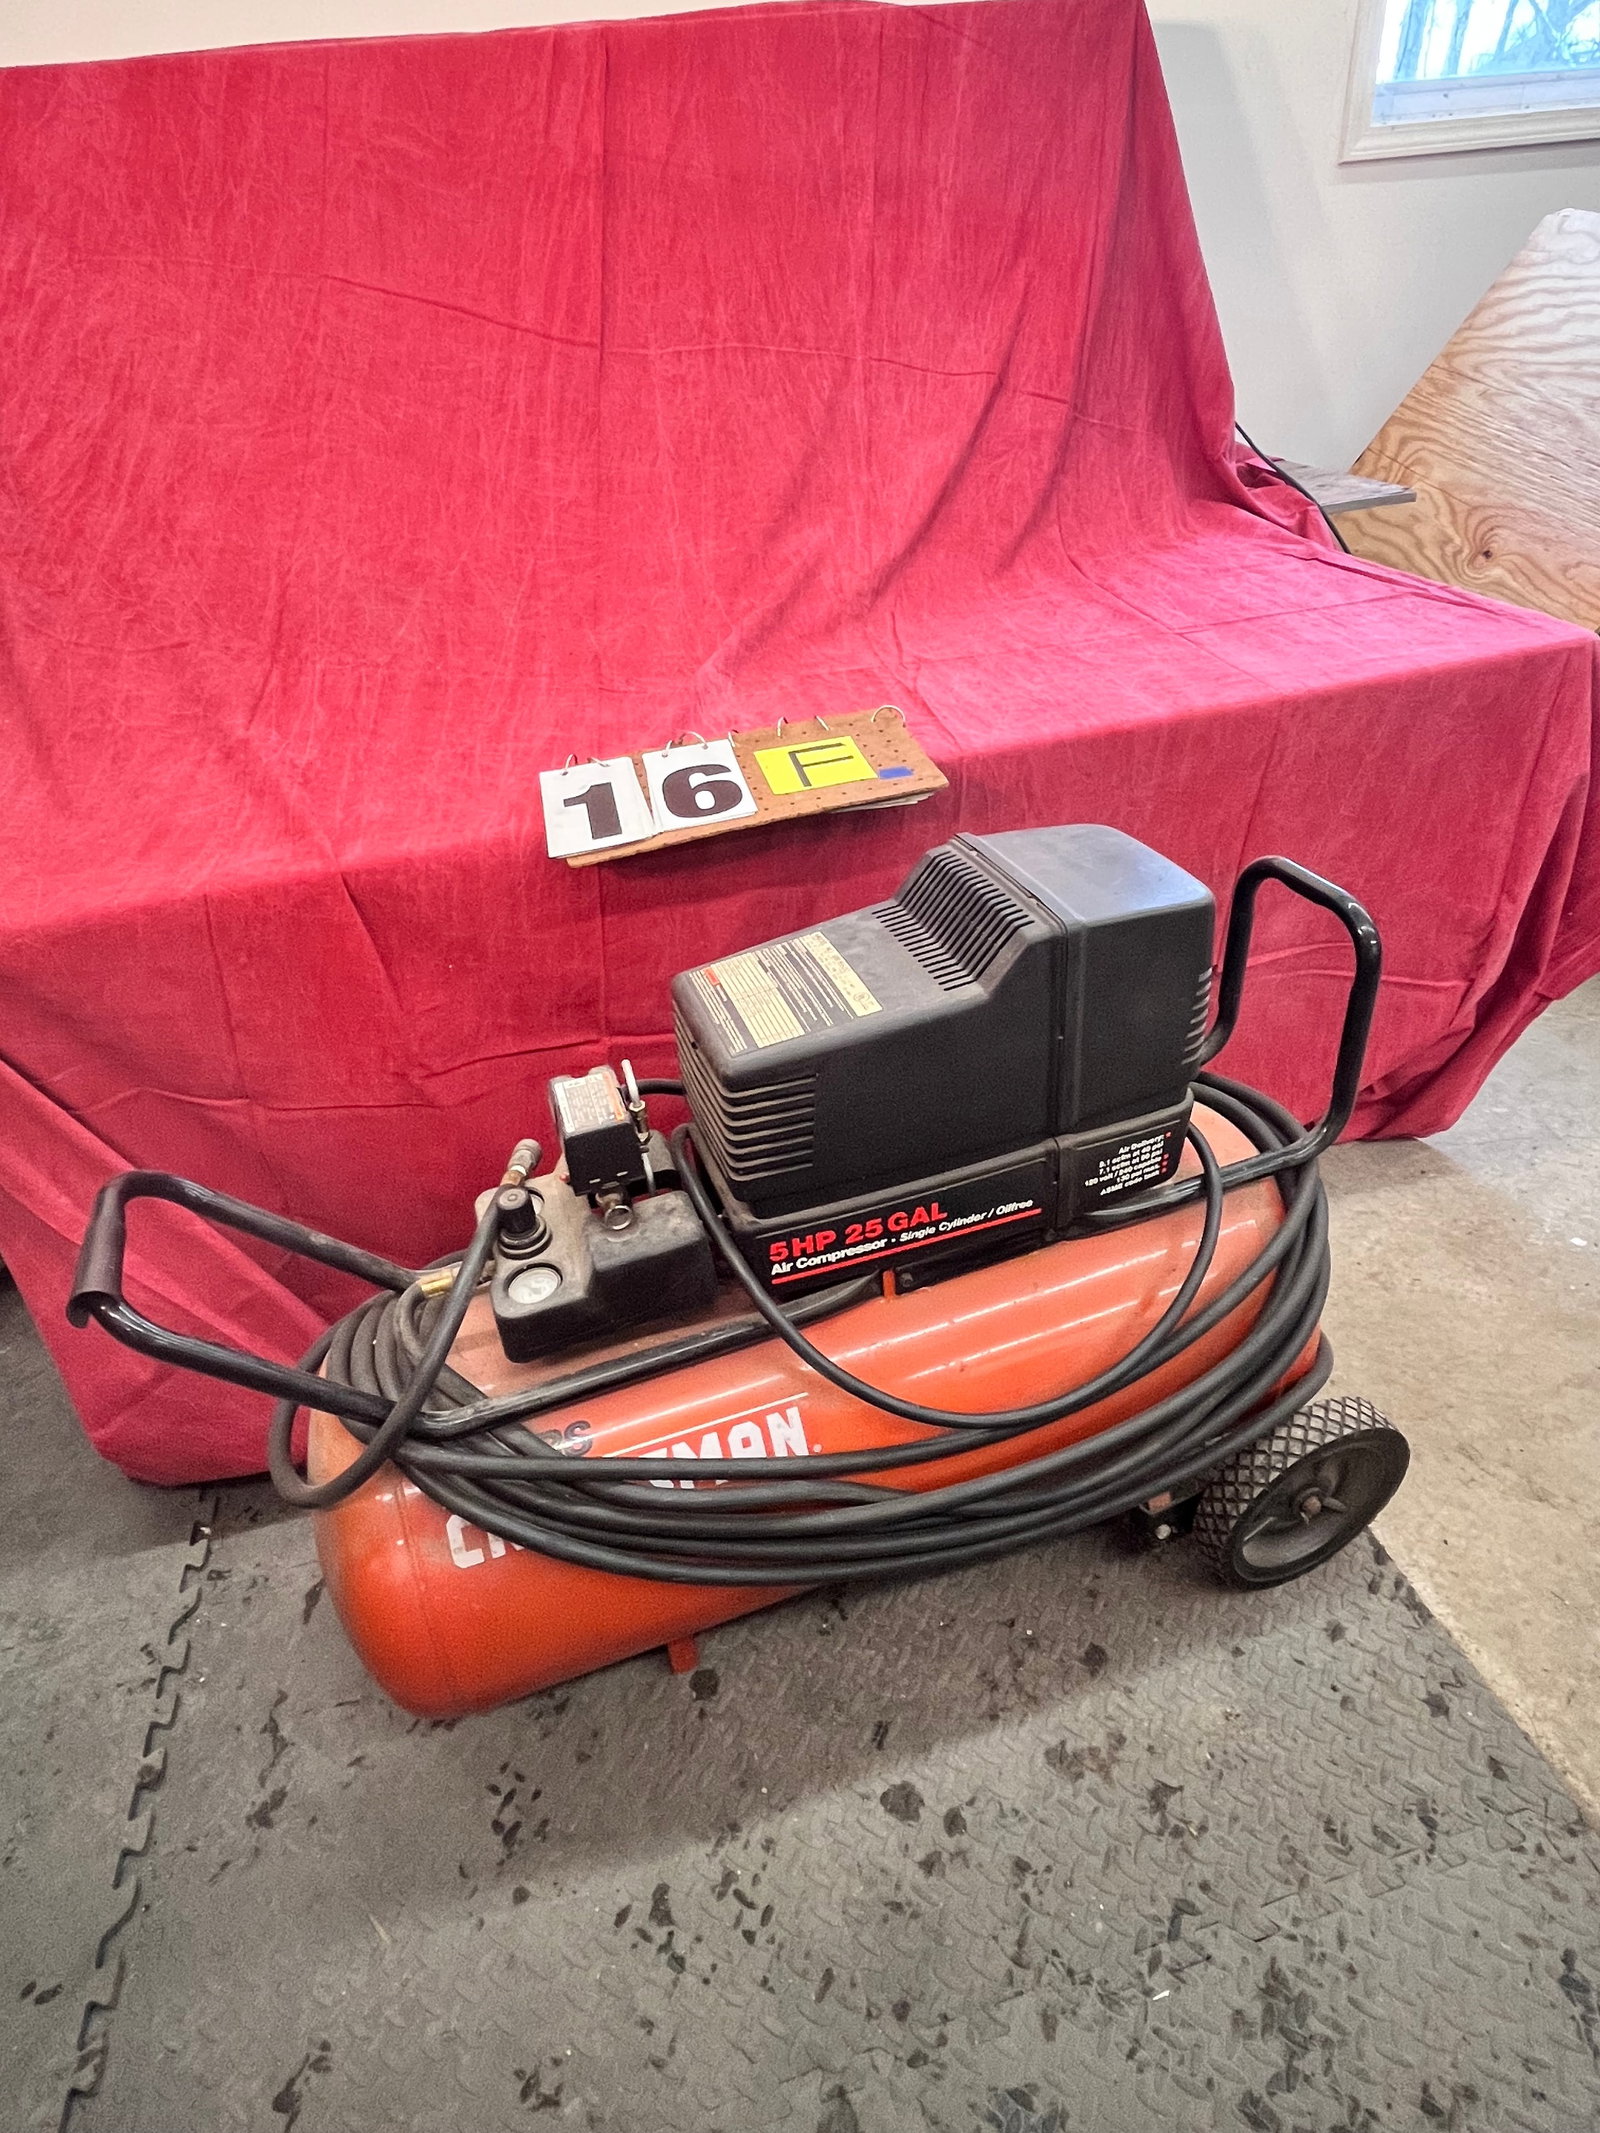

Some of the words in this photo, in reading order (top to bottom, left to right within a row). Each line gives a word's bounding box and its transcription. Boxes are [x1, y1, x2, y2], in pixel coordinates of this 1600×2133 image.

[788, 742, 854, 788] F
[1119, 1145, 1130, 1155] Air
[770, 1262, 794, 1276] Air
[795, 1238, 888, 1270] Compressor
[899, 1226, 936, 1243] Single
[939, 1211, 988, 1232] Cylinder
[996, 1200, 1034, 1215] Oilfree
